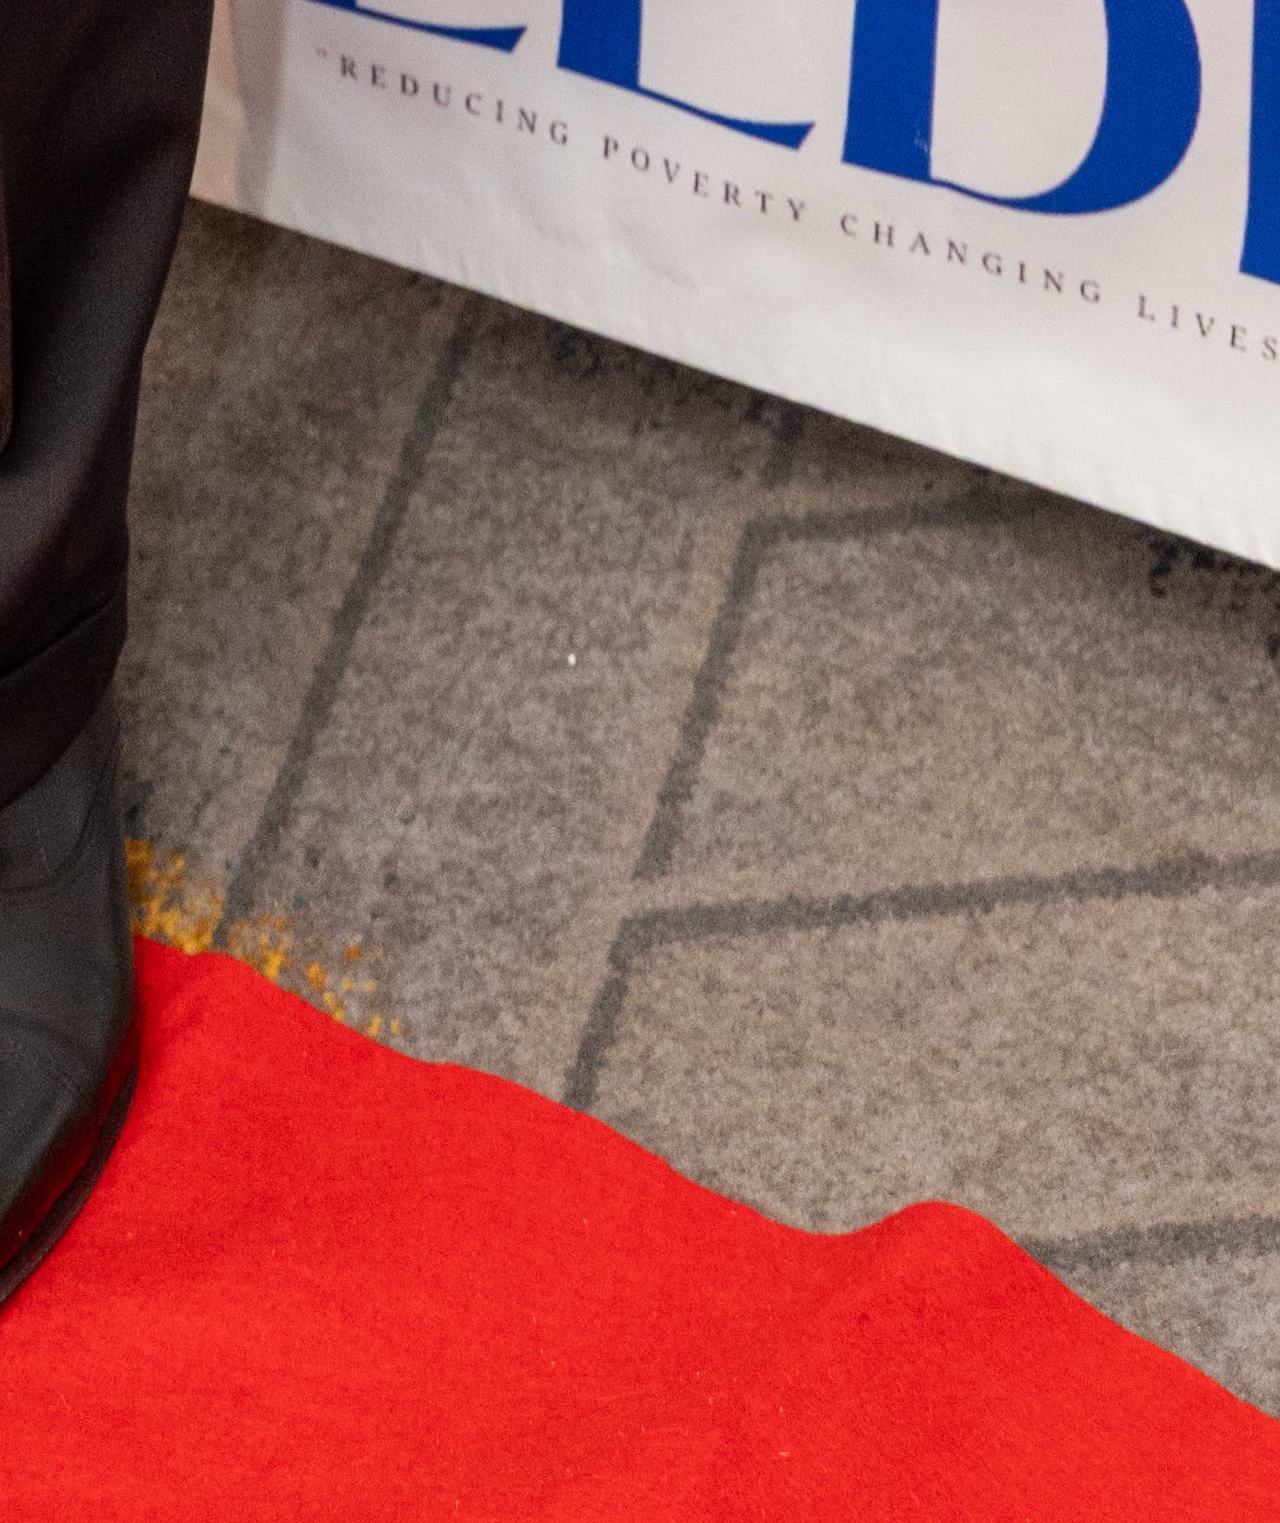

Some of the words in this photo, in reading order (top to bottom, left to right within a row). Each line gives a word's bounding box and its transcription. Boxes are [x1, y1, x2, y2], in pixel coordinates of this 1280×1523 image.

[316, 48, 569, 148] "REDUCING
[603, 136, 806, 221] POVERTY
[840, 213, 1101, 305] CHANGING
